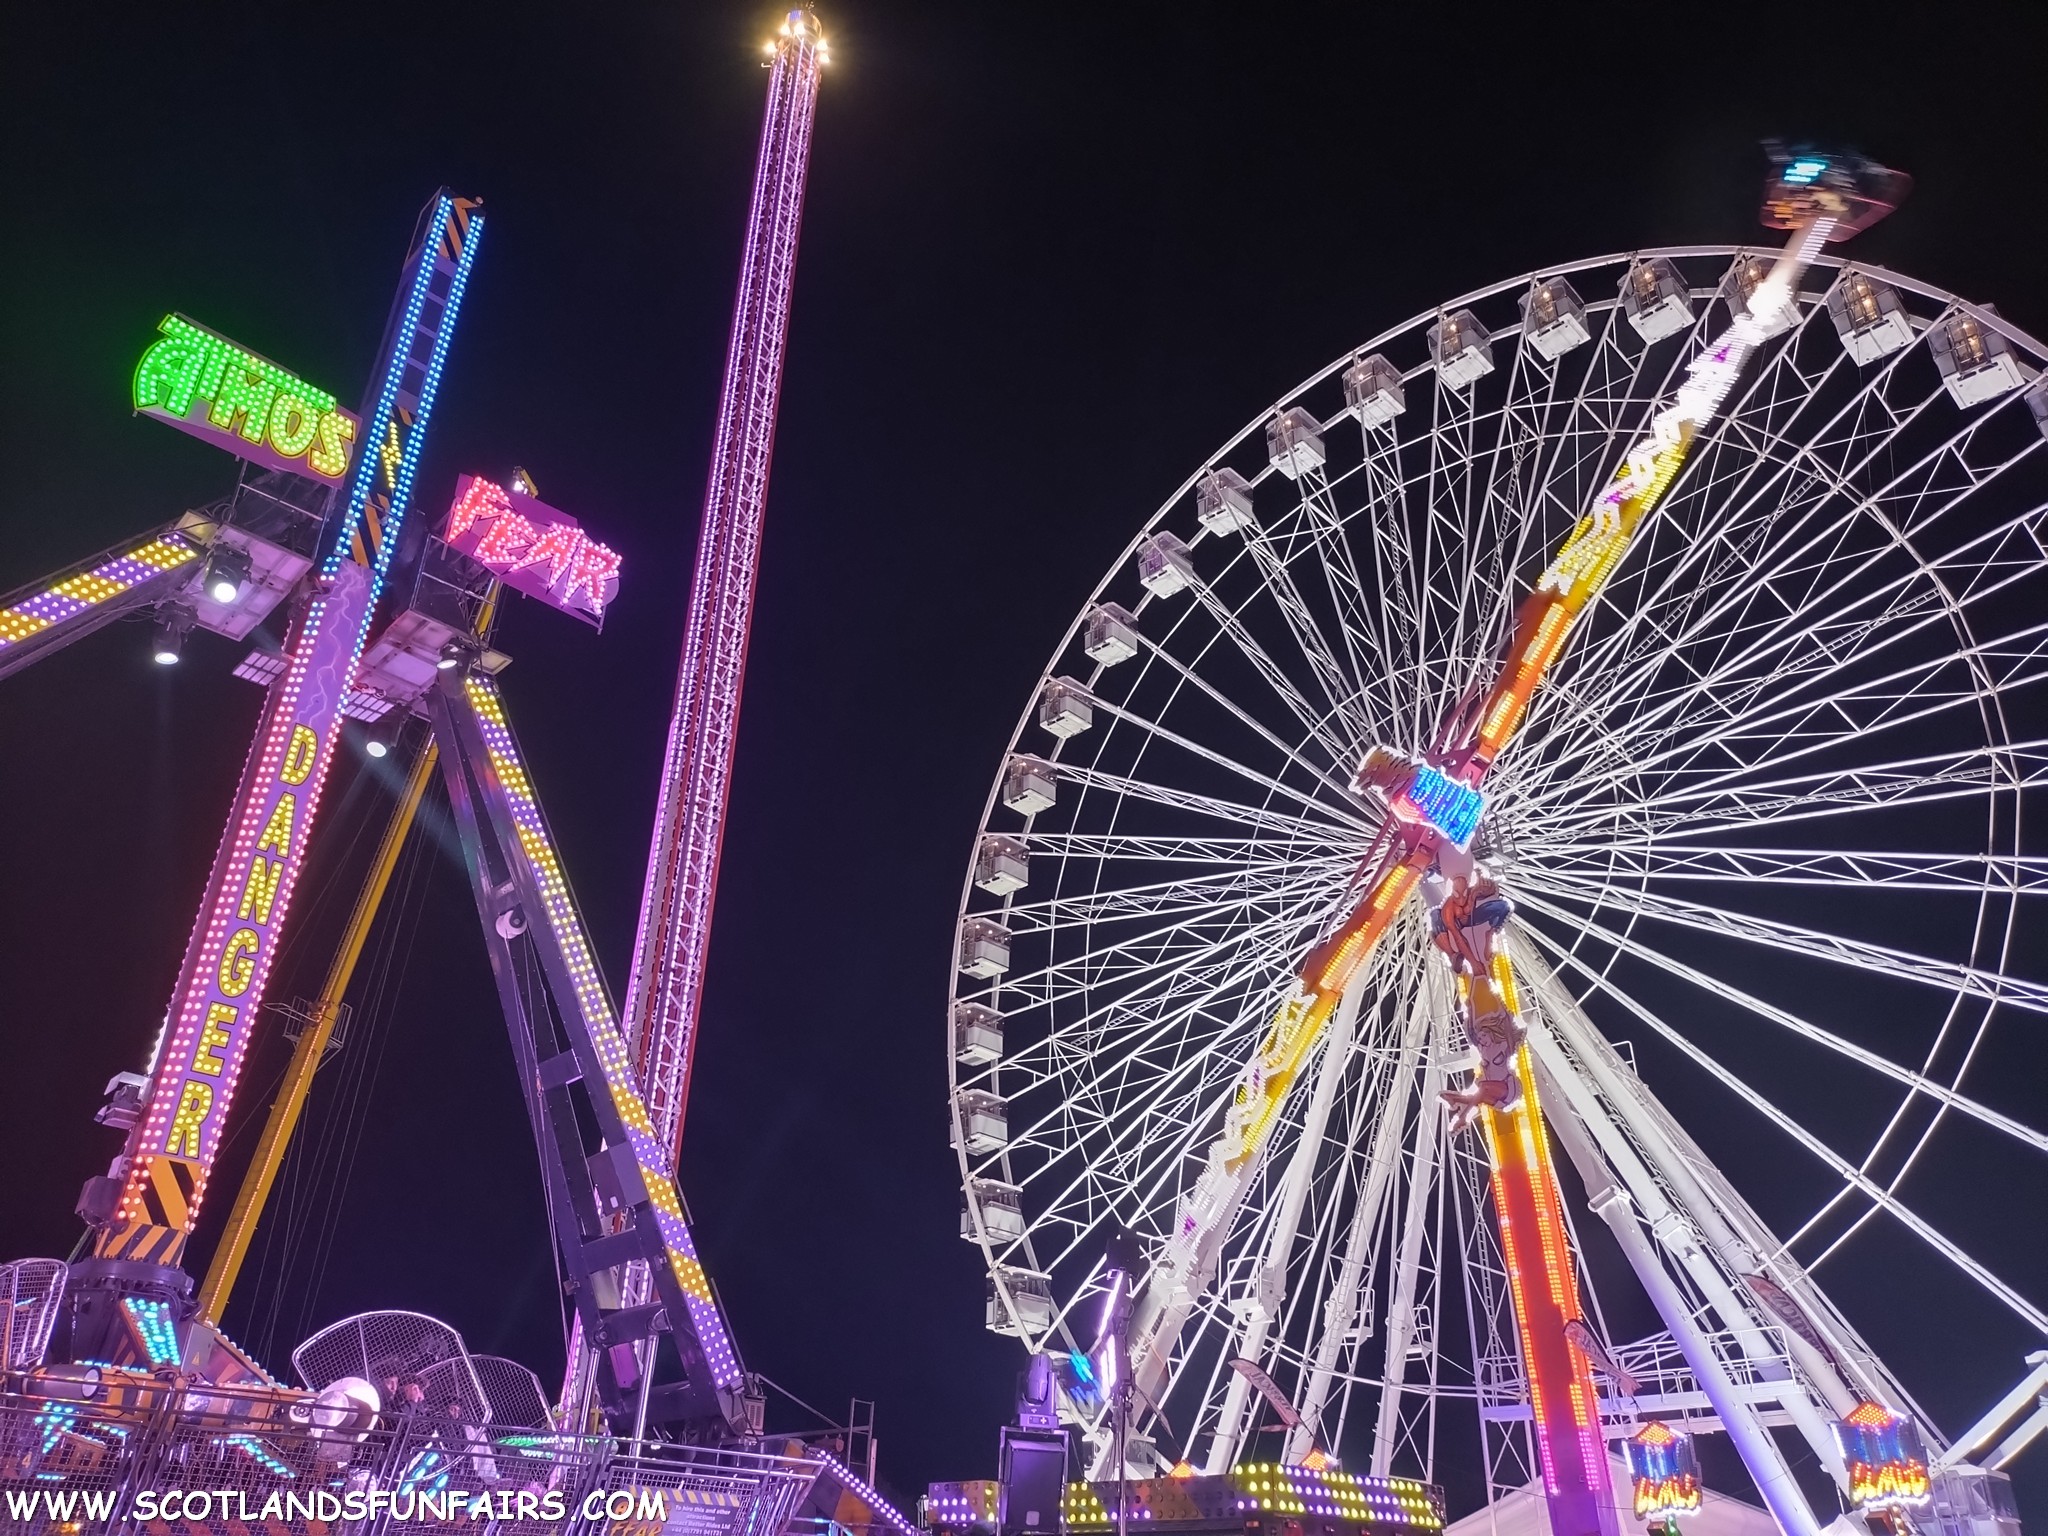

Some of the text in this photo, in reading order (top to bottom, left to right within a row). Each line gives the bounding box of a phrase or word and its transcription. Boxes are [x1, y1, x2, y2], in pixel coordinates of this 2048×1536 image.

[132, 313, 356, 479] ATMOS
[447, 475, 624, 619] FEAR
[163, 722, 319, 1160] DANGER
